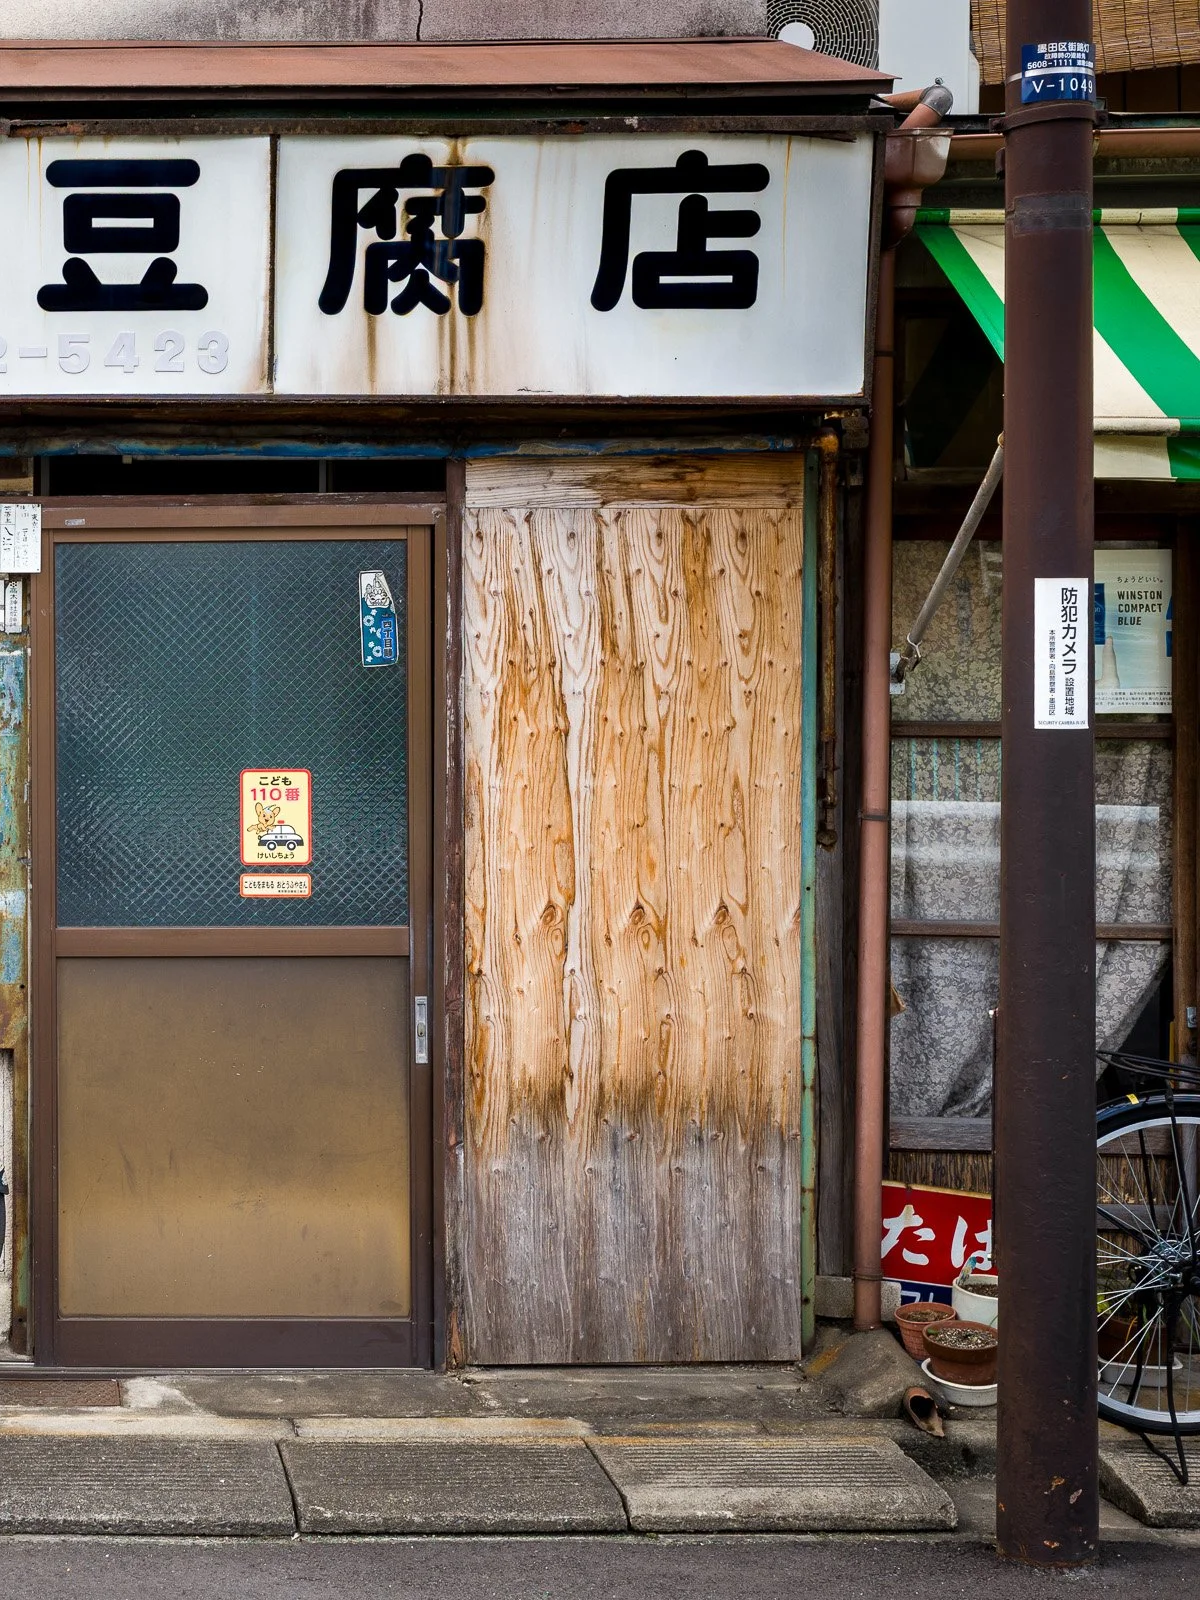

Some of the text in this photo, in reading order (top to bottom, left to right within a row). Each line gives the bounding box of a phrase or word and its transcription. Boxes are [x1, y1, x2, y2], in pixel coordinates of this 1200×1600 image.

[1037, 42, 1090, 53] 墨田区街路灯
[1027, 60, 1073, 69] 5608-1111
[1032, 77, 1093, 94] V-1049
[1117, 576, 1164, 584] ちょうどいい。
[1117, 590, 1162, 600] WINSTON
[1118, 603, 1162, 613] COMPACT
[1117, 616, 1142, 626] BLUE
[1060, 587, 1078, 716] 防犯カメラ設置地域
[259, 775, 292, 786] こども
[250, 788, 300, 801] 110番
